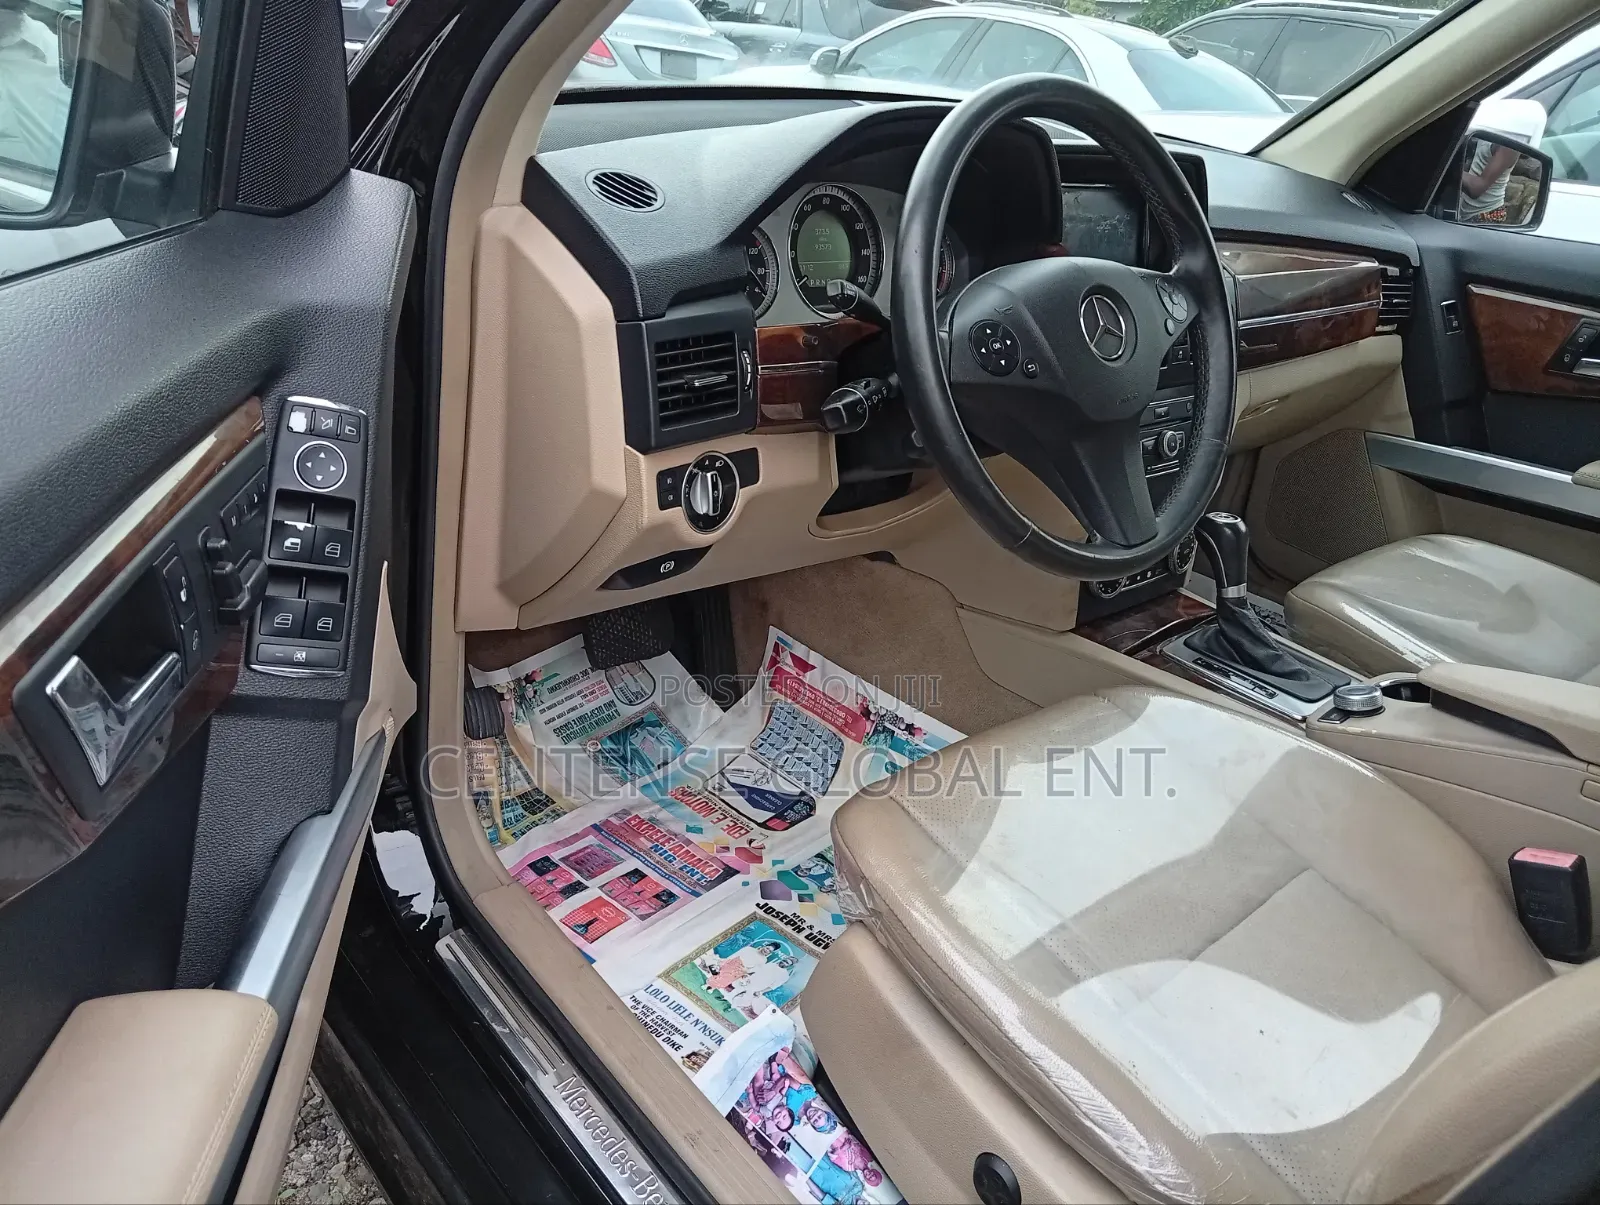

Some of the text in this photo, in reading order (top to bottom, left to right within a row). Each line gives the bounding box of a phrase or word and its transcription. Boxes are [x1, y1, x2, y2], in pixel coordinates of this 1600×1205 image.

[822, 197, 831, 205] 80
[840, 204, 850, 212] 100
[854, 222, 864, 230] 120
[861, 248, 870, 256] 140
[992, 342, 1002, 350] OK
[553, 699, 618, 738] AND DESPERATE CASES
[587, 721, 596, 732] OF
[596, 711, 617, 726] PATRON
[561, 726, 588, 745] DIFFICULT
[668, 786, 718, 818] MOTORS
[710, 812, 728, 825] E
[720, 820, 750, 840] EDE
[625, 814, 677, 847] EKPELE
[668, 843, 722, 880] AMAKA
[650, 844, 708, 886] NIG. ENT.
[755, 902, 806, 934] JOSEPH
[790, 912, 806, 926] MR
[643, 984, 670, 1004] LOLO
[666, 1000, 694, 1022] IJELE
[629, 994, 690, 1040] THE VICE CHAIRMAN
[640, 1010, 650, 1020] THE
[649, 1016, 676, 1038] HARVEST
[662, 1036, 684, 1052] DIKE
[553, 1074, 668, 1205] Mercedes-Be
